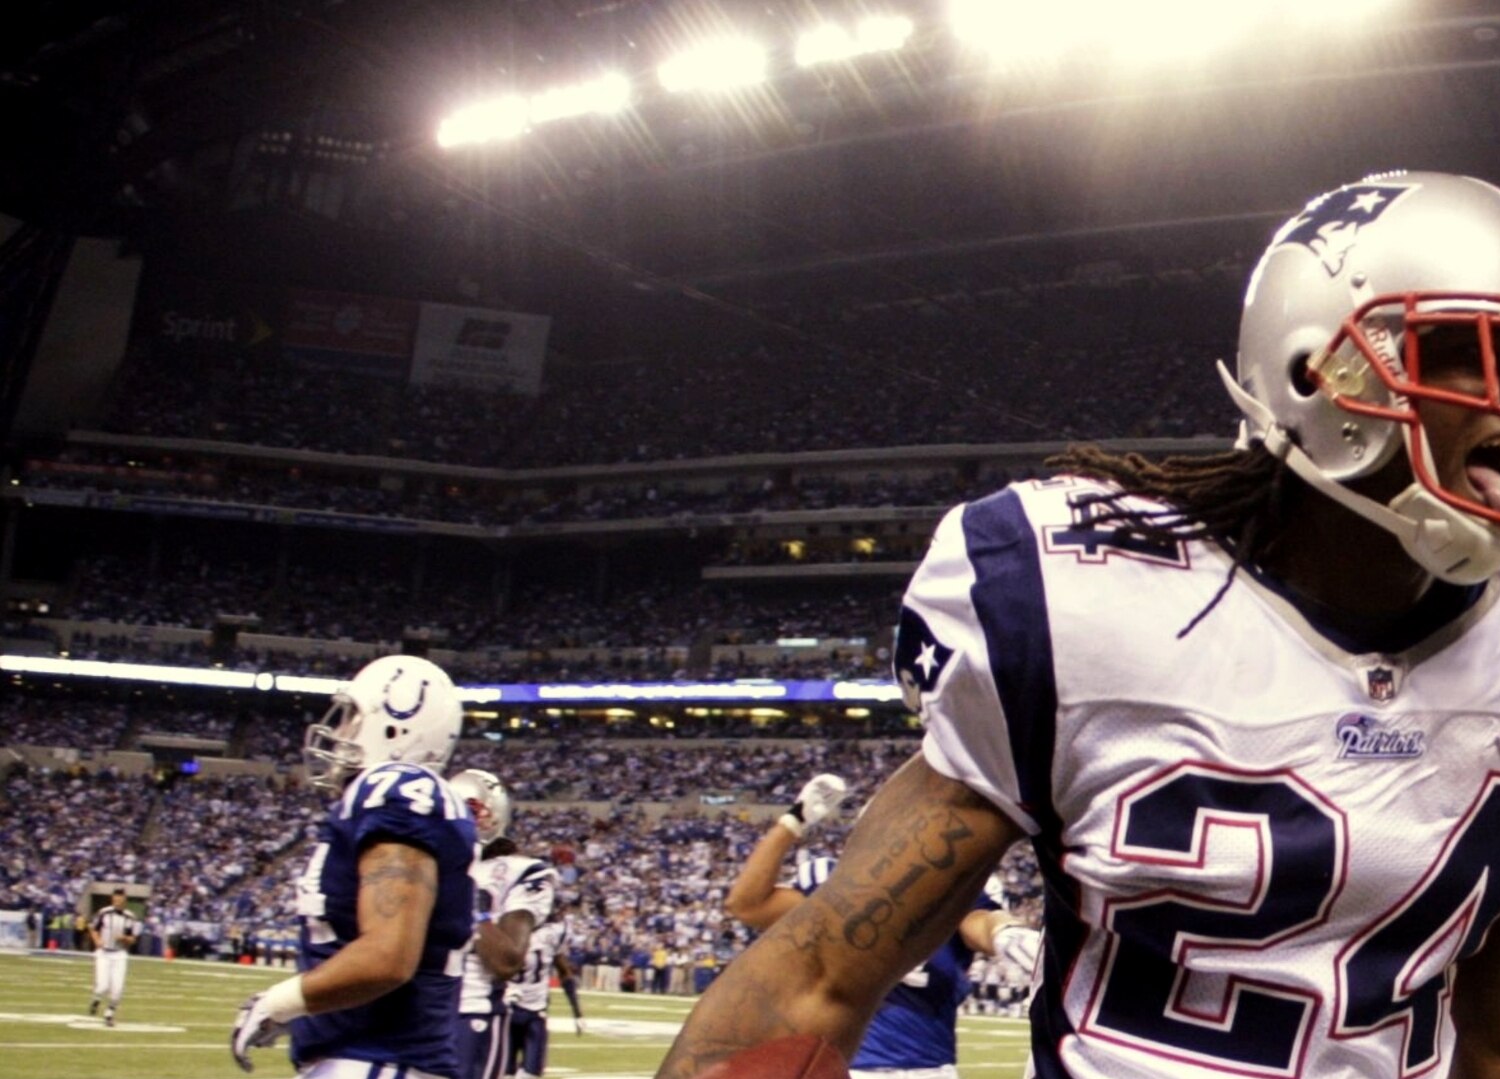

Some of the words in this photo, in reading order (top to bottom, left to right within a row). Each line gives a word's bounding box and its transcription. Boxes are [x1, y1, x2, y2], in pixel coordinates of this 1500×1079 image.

[159, 309, 237, 344] Sprint
[1337, 725, 1425, 759] Patriots
[362, 771, 435, 816] 74
